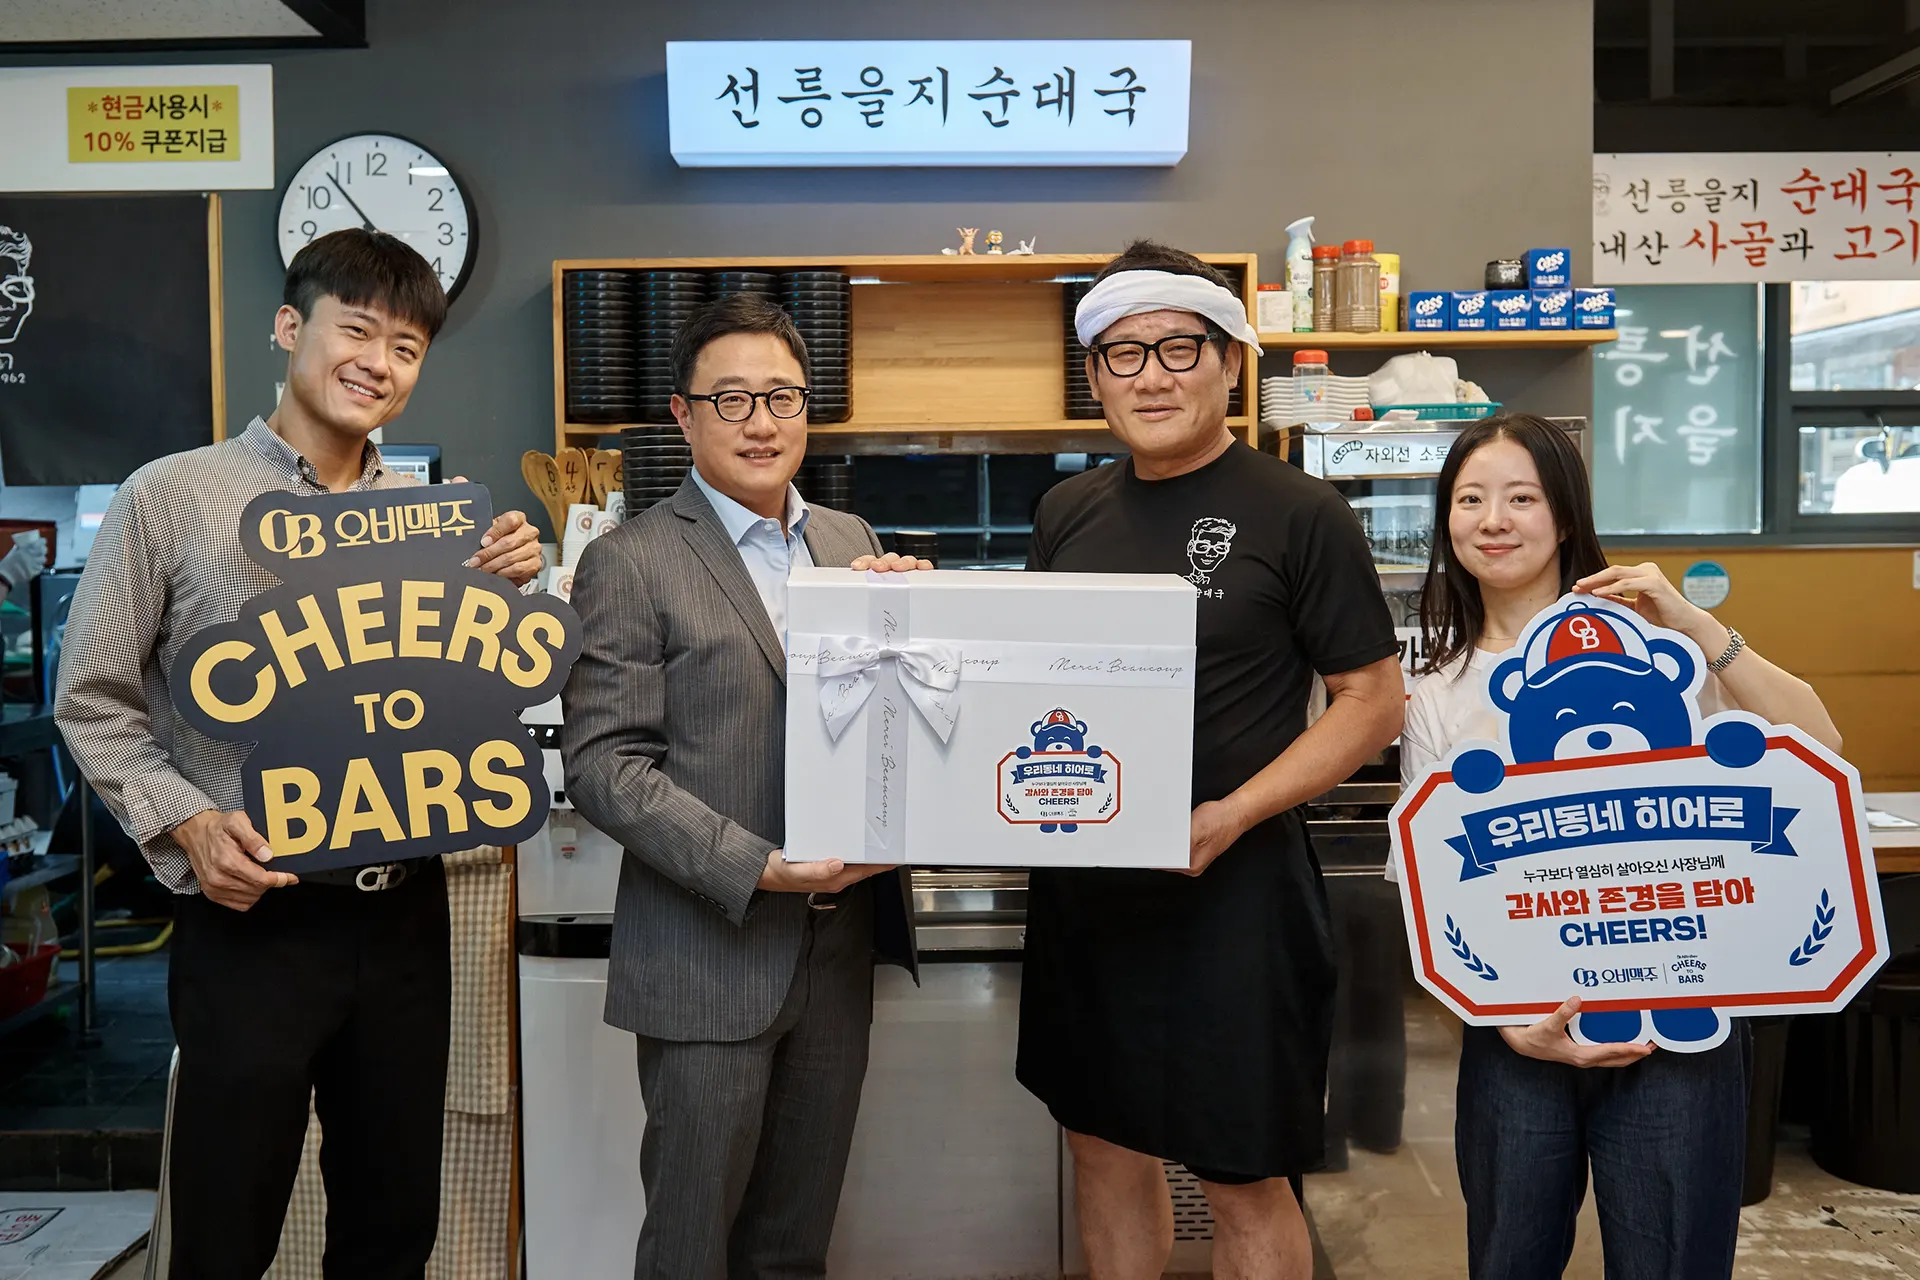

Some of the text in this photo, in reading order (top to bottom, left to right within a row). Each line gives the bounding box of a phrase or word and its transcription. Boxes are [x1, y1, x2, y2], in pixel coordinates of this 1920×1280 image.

[84, 129, 227, 153] 10% 쿠폰지급
[335, 161, 351, 185] 11
[366, 153, 388, 176] 12
[307, 186, 331, 210] 10
[427, 188, 444, 211] 2
[1622, 167, 1920, 215] 선릉을지 순대국
[301, 220, 317, 243] 9
[438, 222, 454, 246] 3
[1592, 219, 1920, 268] 내산 사골과 고기
[1365, 446, 1410, 463] 자외선
[566, 461, 578, 484] 4
[259, 500, 475, 560] OB 오비맥주
[1364, 529, 1432, 549] STER
[1569, 616, 1600, 650] OB
[190, 580, 566, 723] CHEERS
[961, 657, 1000, 671] coup
[1049, 657, 1183, 678] Merci Beaucoup
[354, 689, 424, 733] TO
[875, 696, 898, 828] Merci Beaucoup
[1023, 764, 1095, 776] 우리동네 히어로
[261, 739, 532, 857] BARS
[1487, 796, 1745, 848] 우리동네 히어로
[1523, 854, 1726, 883] 누구보다 열심히 살아오신 사장님께
[1505, 877, 1755, 920] 감사와 존경을 담아
[1559, 914, 1708, 947] CHEERS!
[1573, 967, 1658, 987] OB 오비맥주
[1671, 960, 1707, 972] CHEERS
[1678, 974, 1704, 984] BARS
